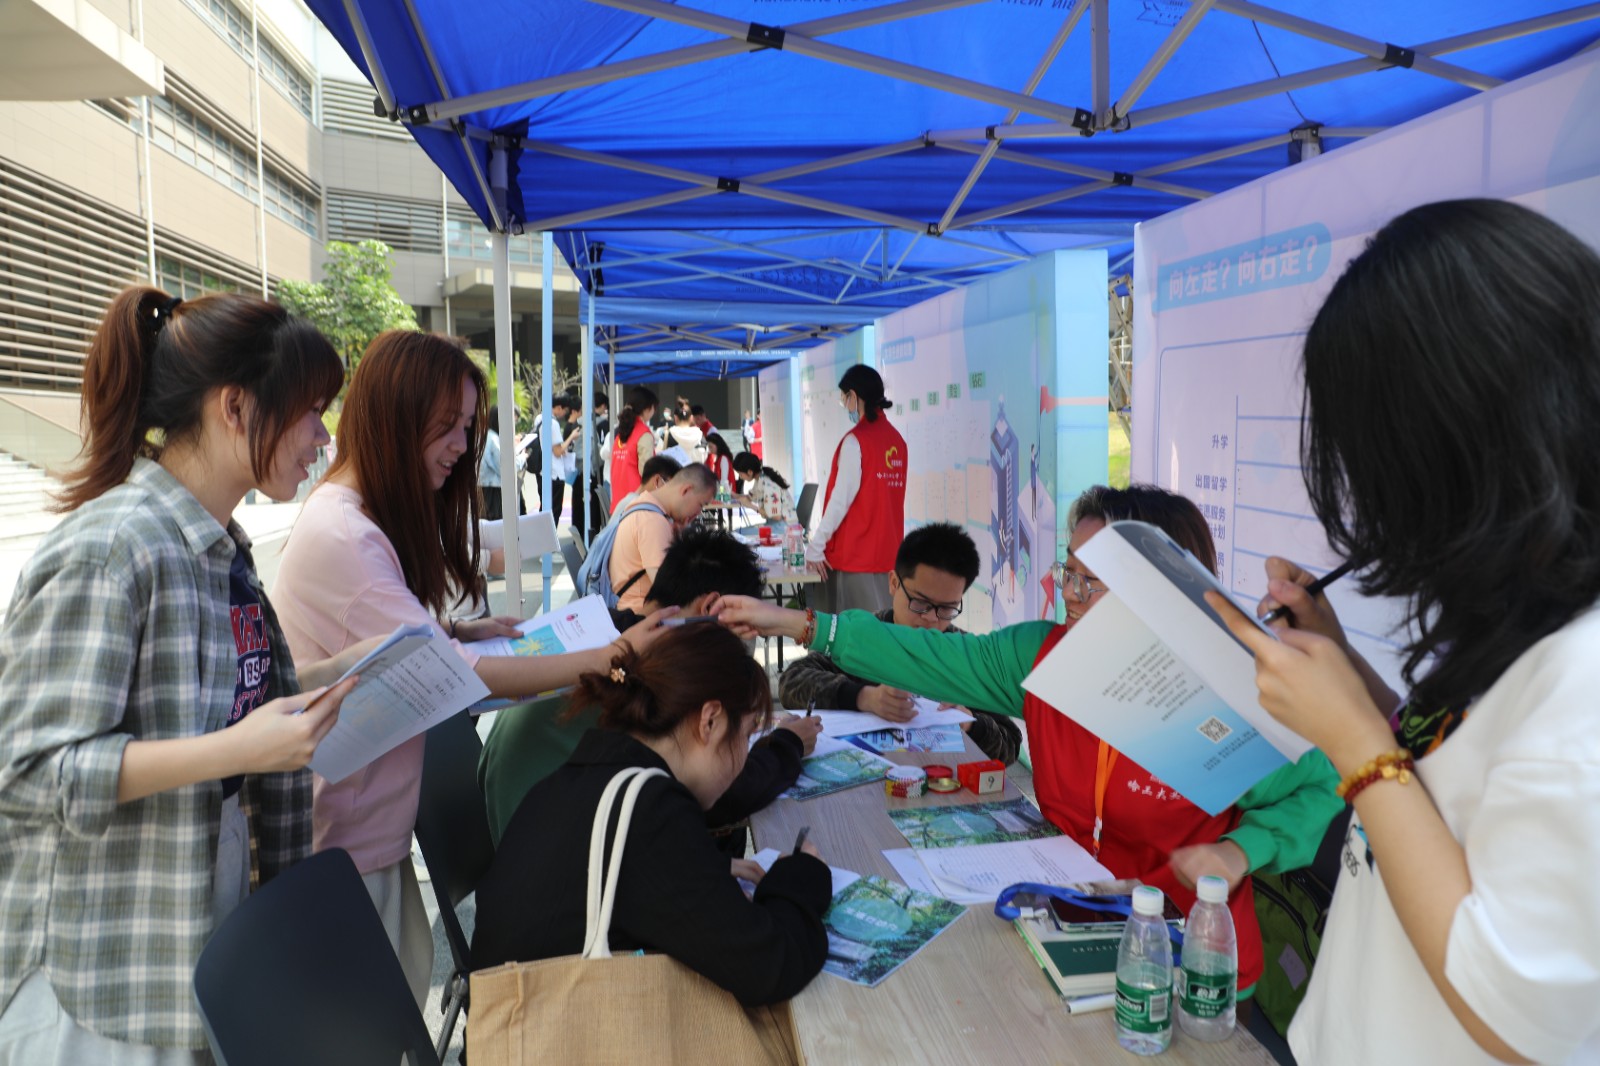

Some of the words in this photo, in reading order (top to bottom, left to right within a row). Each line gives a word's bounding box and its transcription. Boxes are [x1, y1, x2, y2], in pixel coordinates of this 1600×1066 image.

[1212, 434, 1228, 449] 升学
[1195, 474, 1227, 491] 出国留学
